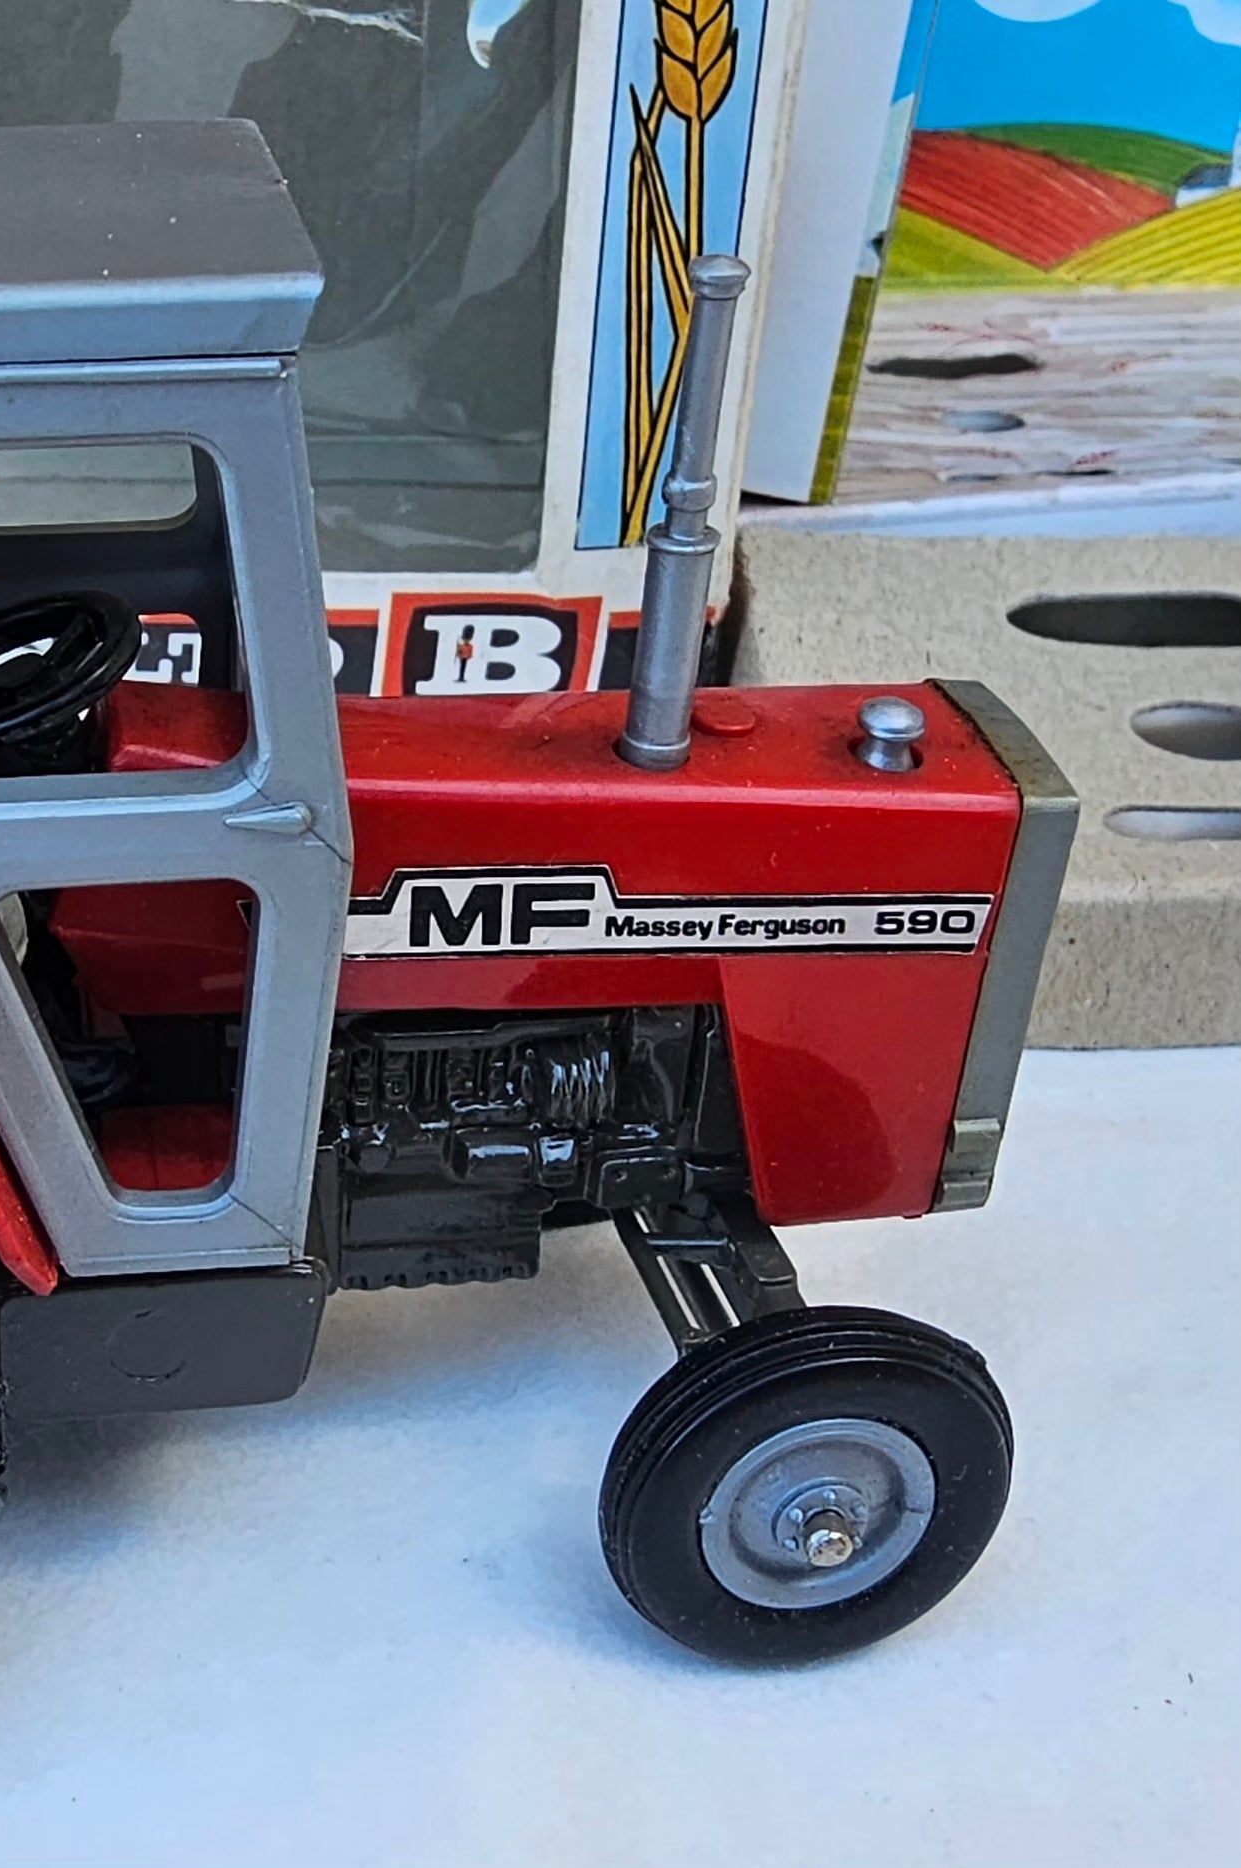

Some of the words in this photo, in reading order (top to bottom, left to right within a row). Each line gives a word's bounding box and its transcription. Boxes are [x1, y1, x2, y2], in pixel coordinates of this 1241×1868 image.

[408, 882, 596, 947] MF
[604, 914, 712, 938] Massey
[717, 914, 846, 938] Ferguson
[873, 910, 976, 935] 590
